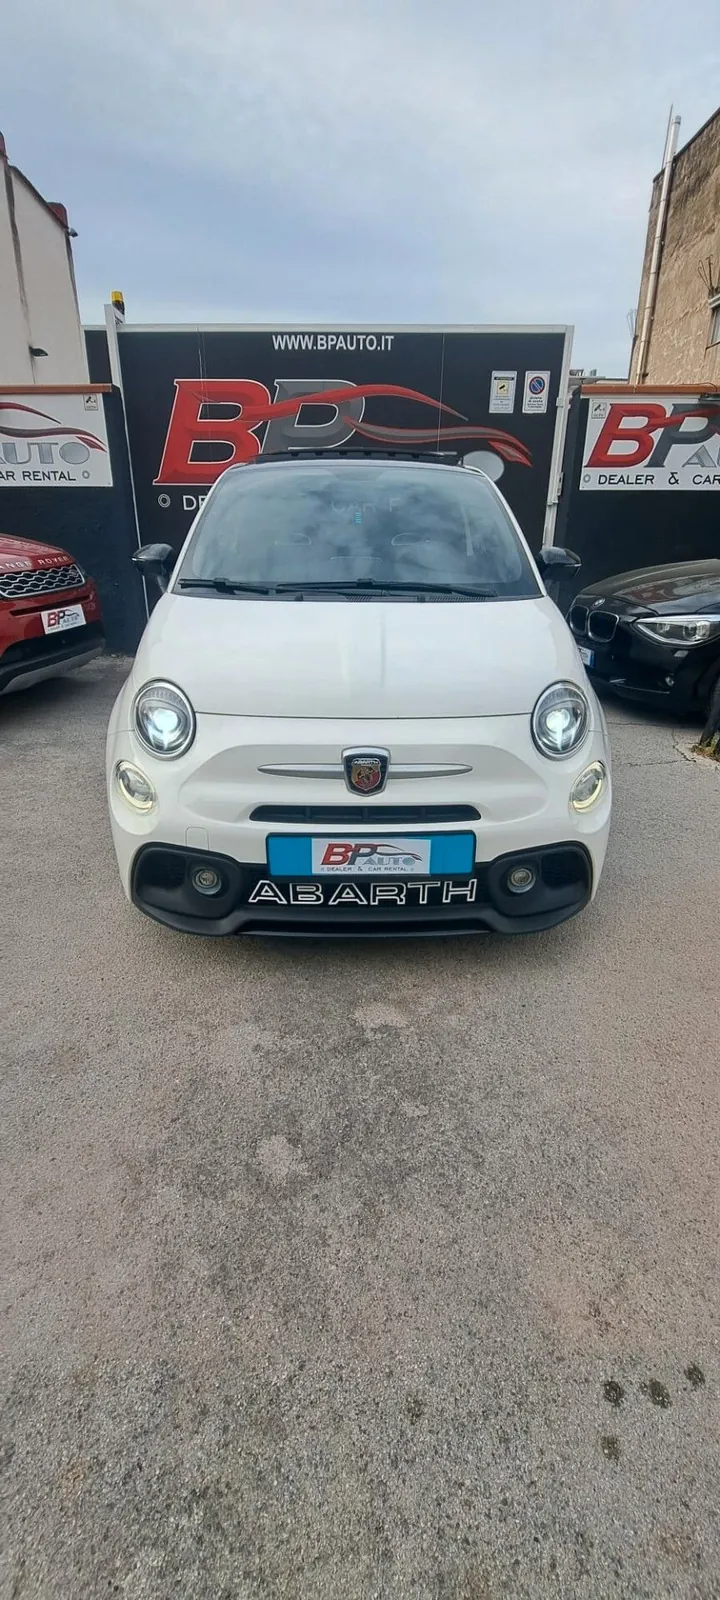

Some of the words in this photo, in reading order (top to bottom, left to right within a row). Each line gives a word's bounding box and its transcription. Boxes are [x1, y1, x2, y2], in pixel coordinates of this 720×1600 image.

[272, 334, 395, 351] WWW.BPAUTO.IT
[583, 403, 720, 468] BP
[0, 441, 91, 465] UTO
[22, 470, 77, 481] RENTAL
[598, 474, 655, 485] DEALER
[668, 472, 680, 485] &
[38, 555, 70, 565] ROVER
[320, 843, 378, 866] BP
[361, 856, 416, 866] AUTO
[248, 879, 478, 905] ABARTH
